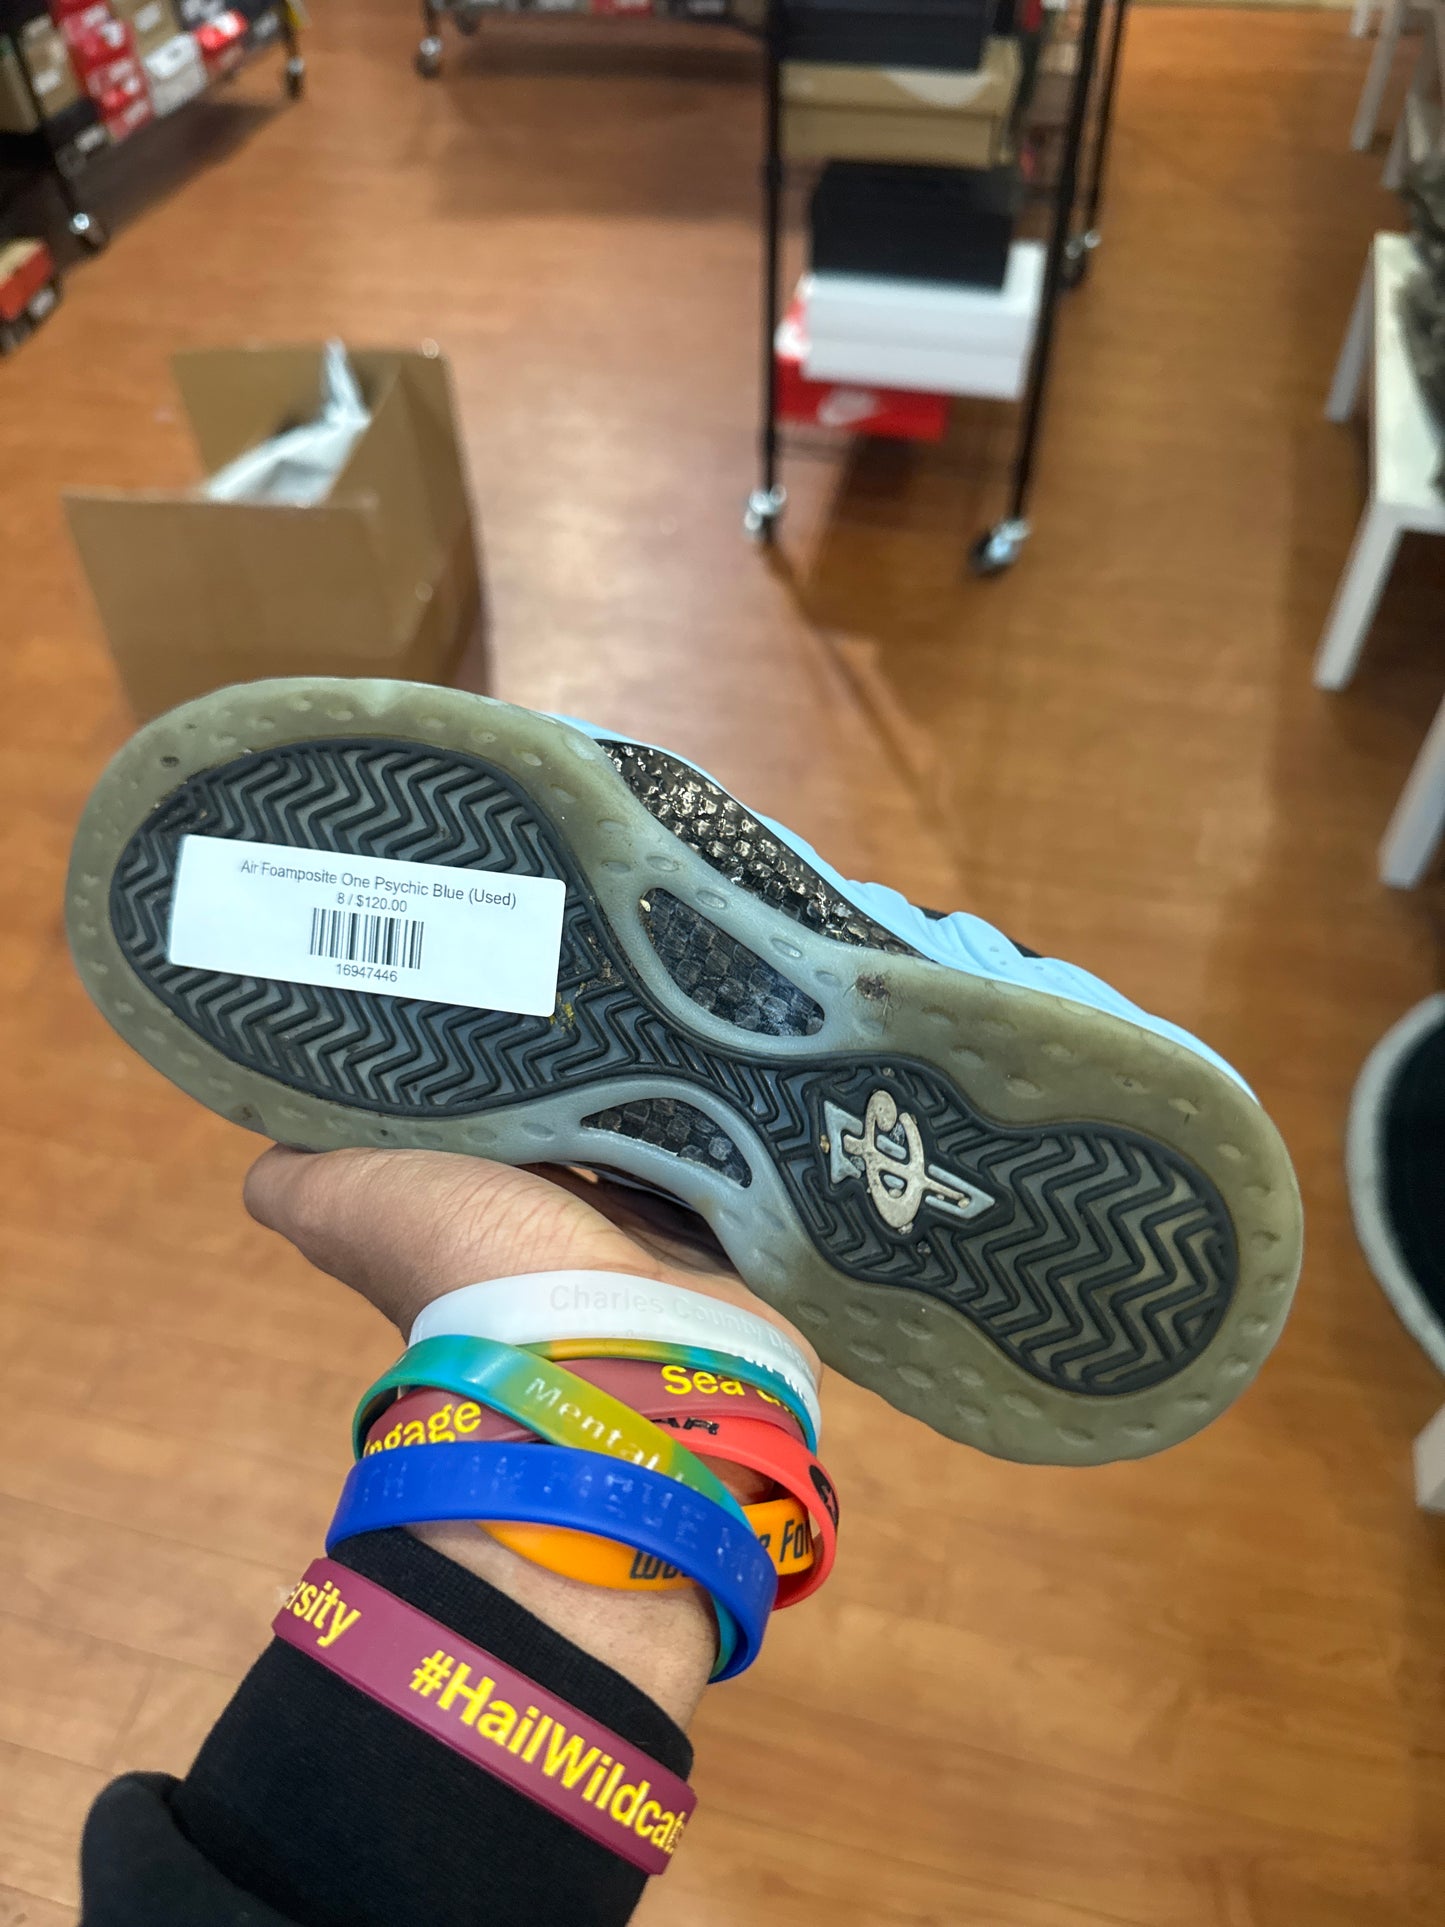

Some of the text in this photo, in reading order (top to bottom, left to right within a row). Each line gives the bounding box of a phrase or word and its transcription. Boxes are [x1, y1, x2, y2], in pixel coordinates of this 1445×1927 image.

[240, 858, 517, 910] Air Foamposite One Psychic Blue (Used)
[336, 892, 346, 905] 8
[355, 894, 408, 913] $120.00
[335, 963, 398, 983] 16947446
[549, 1283, 665, 1315] Charles
[660, 1364, 746, 1397] Sea
[363, 1401, 482, 1458] ngage
[524, 1377, 661, 1471] Mental
[284, 1580, 362, 1648] rsity
[409, 1649, 687, 1855] #HailWildcat
